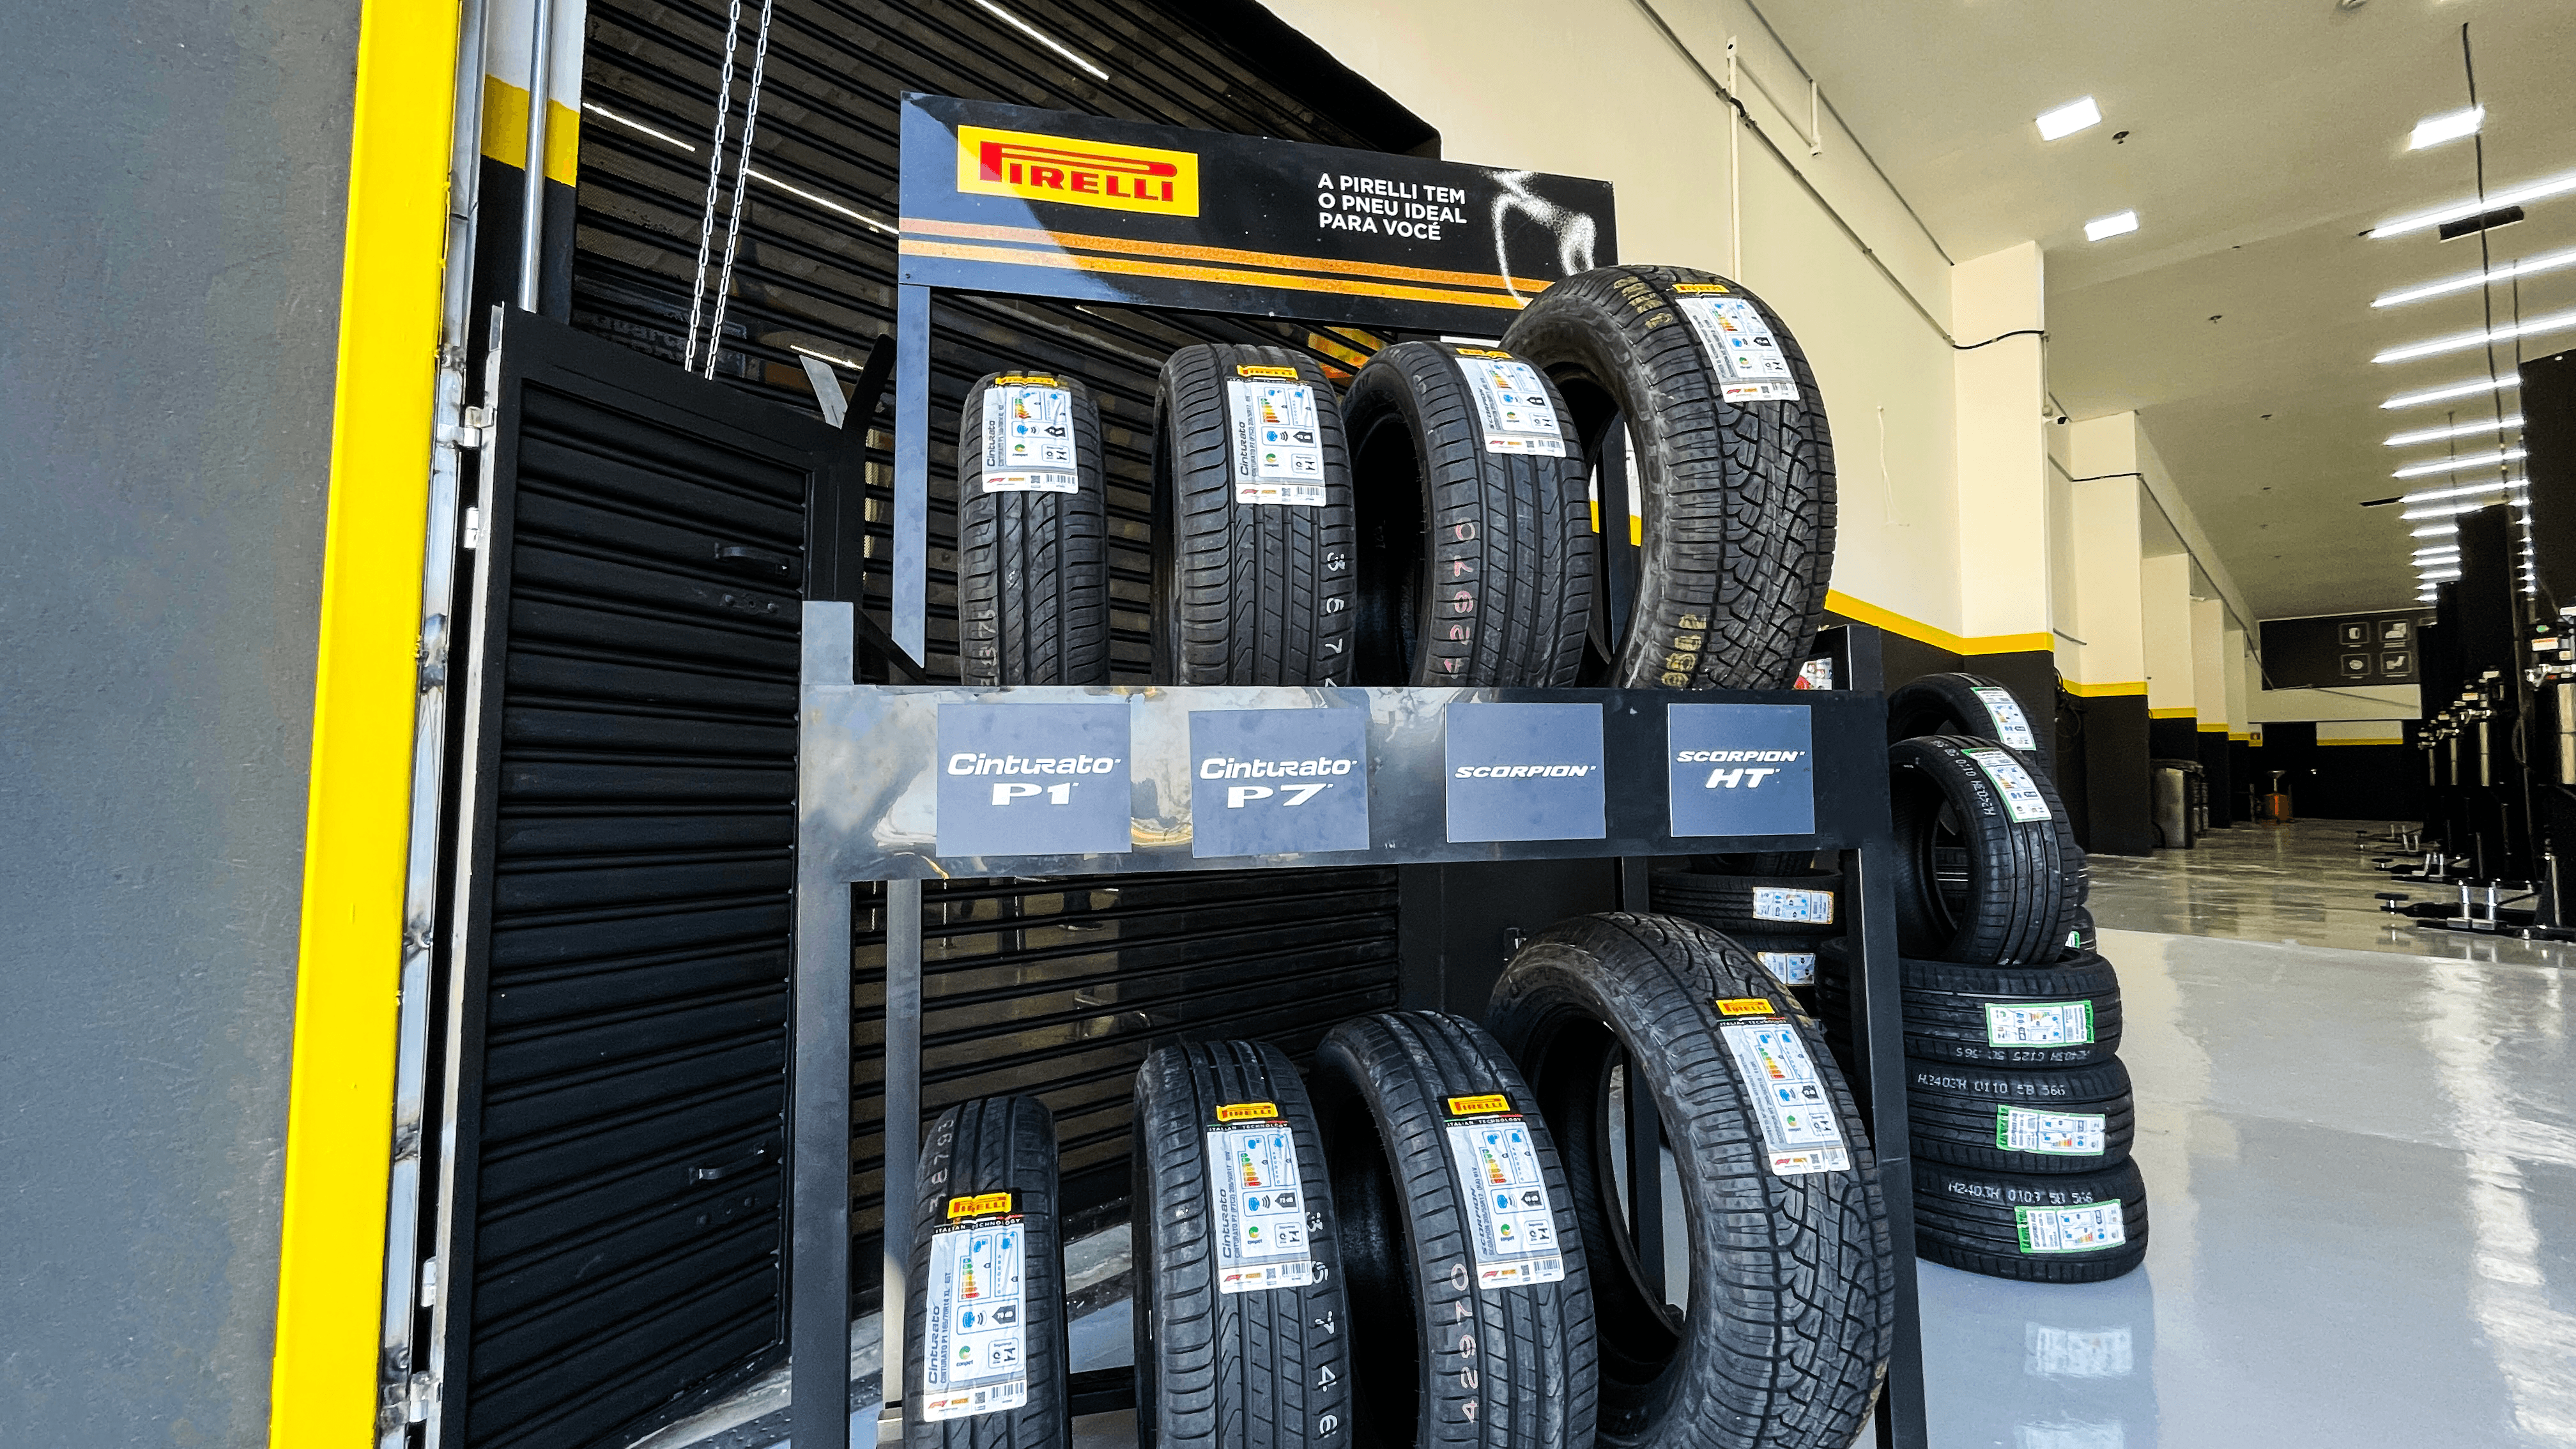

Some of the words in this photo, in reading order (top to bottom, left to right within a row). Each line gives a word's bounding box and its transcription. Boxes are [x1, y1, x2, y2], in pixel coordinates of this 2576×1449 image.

[980, 141, 1177, 202] PIRELLI
[1318, 172, 1334, 190] A
[1340, 175, 1418, 200] PIRELLI
[1423, 185, 1466, 204] TEM
[1318, 192, 1336, 209] O
[1342, 194, 1399, 217] PNEU
[1405, 202, 1468, 224] IDEAL
[1319, 212, 1378, 233] PARA
[987, 420, 995, 466] Cinturato
[1239, 420, 1249, 475] Cinturato
[947, 753, 1121, 775] Cinturato
[1199, 756, 1358, 779] Cinturato
[1676, 751, 1805, 762] SCORPION
[1454, 765, 1597, 778] SCORPION
[1705, 769, 1781, 788] HT
[991, 782, 1080, 806] P1
[1225, 783, 1334, 808] P7
[1222, 1105, 1271, 1119] PIRELLI
[1454, 1098, 1502, 1111] PIRELLI
[954, 1197, 1006, 1213] PIRELLI
[935, 1225, 966, 1234] ITALIAN
[972, 1218, 1020, 1230] TECHNOLOGY
[1223, 1189, 1232, 1259] Cinturato
[1470, 1186, 1487, 1255] SCORPION
[1232, 1222, 1241, 1259] CINTURATO
[1485, 1225, 1495, 1255] SCORPION
[929, 1306, 940, 1384] Cinturato
